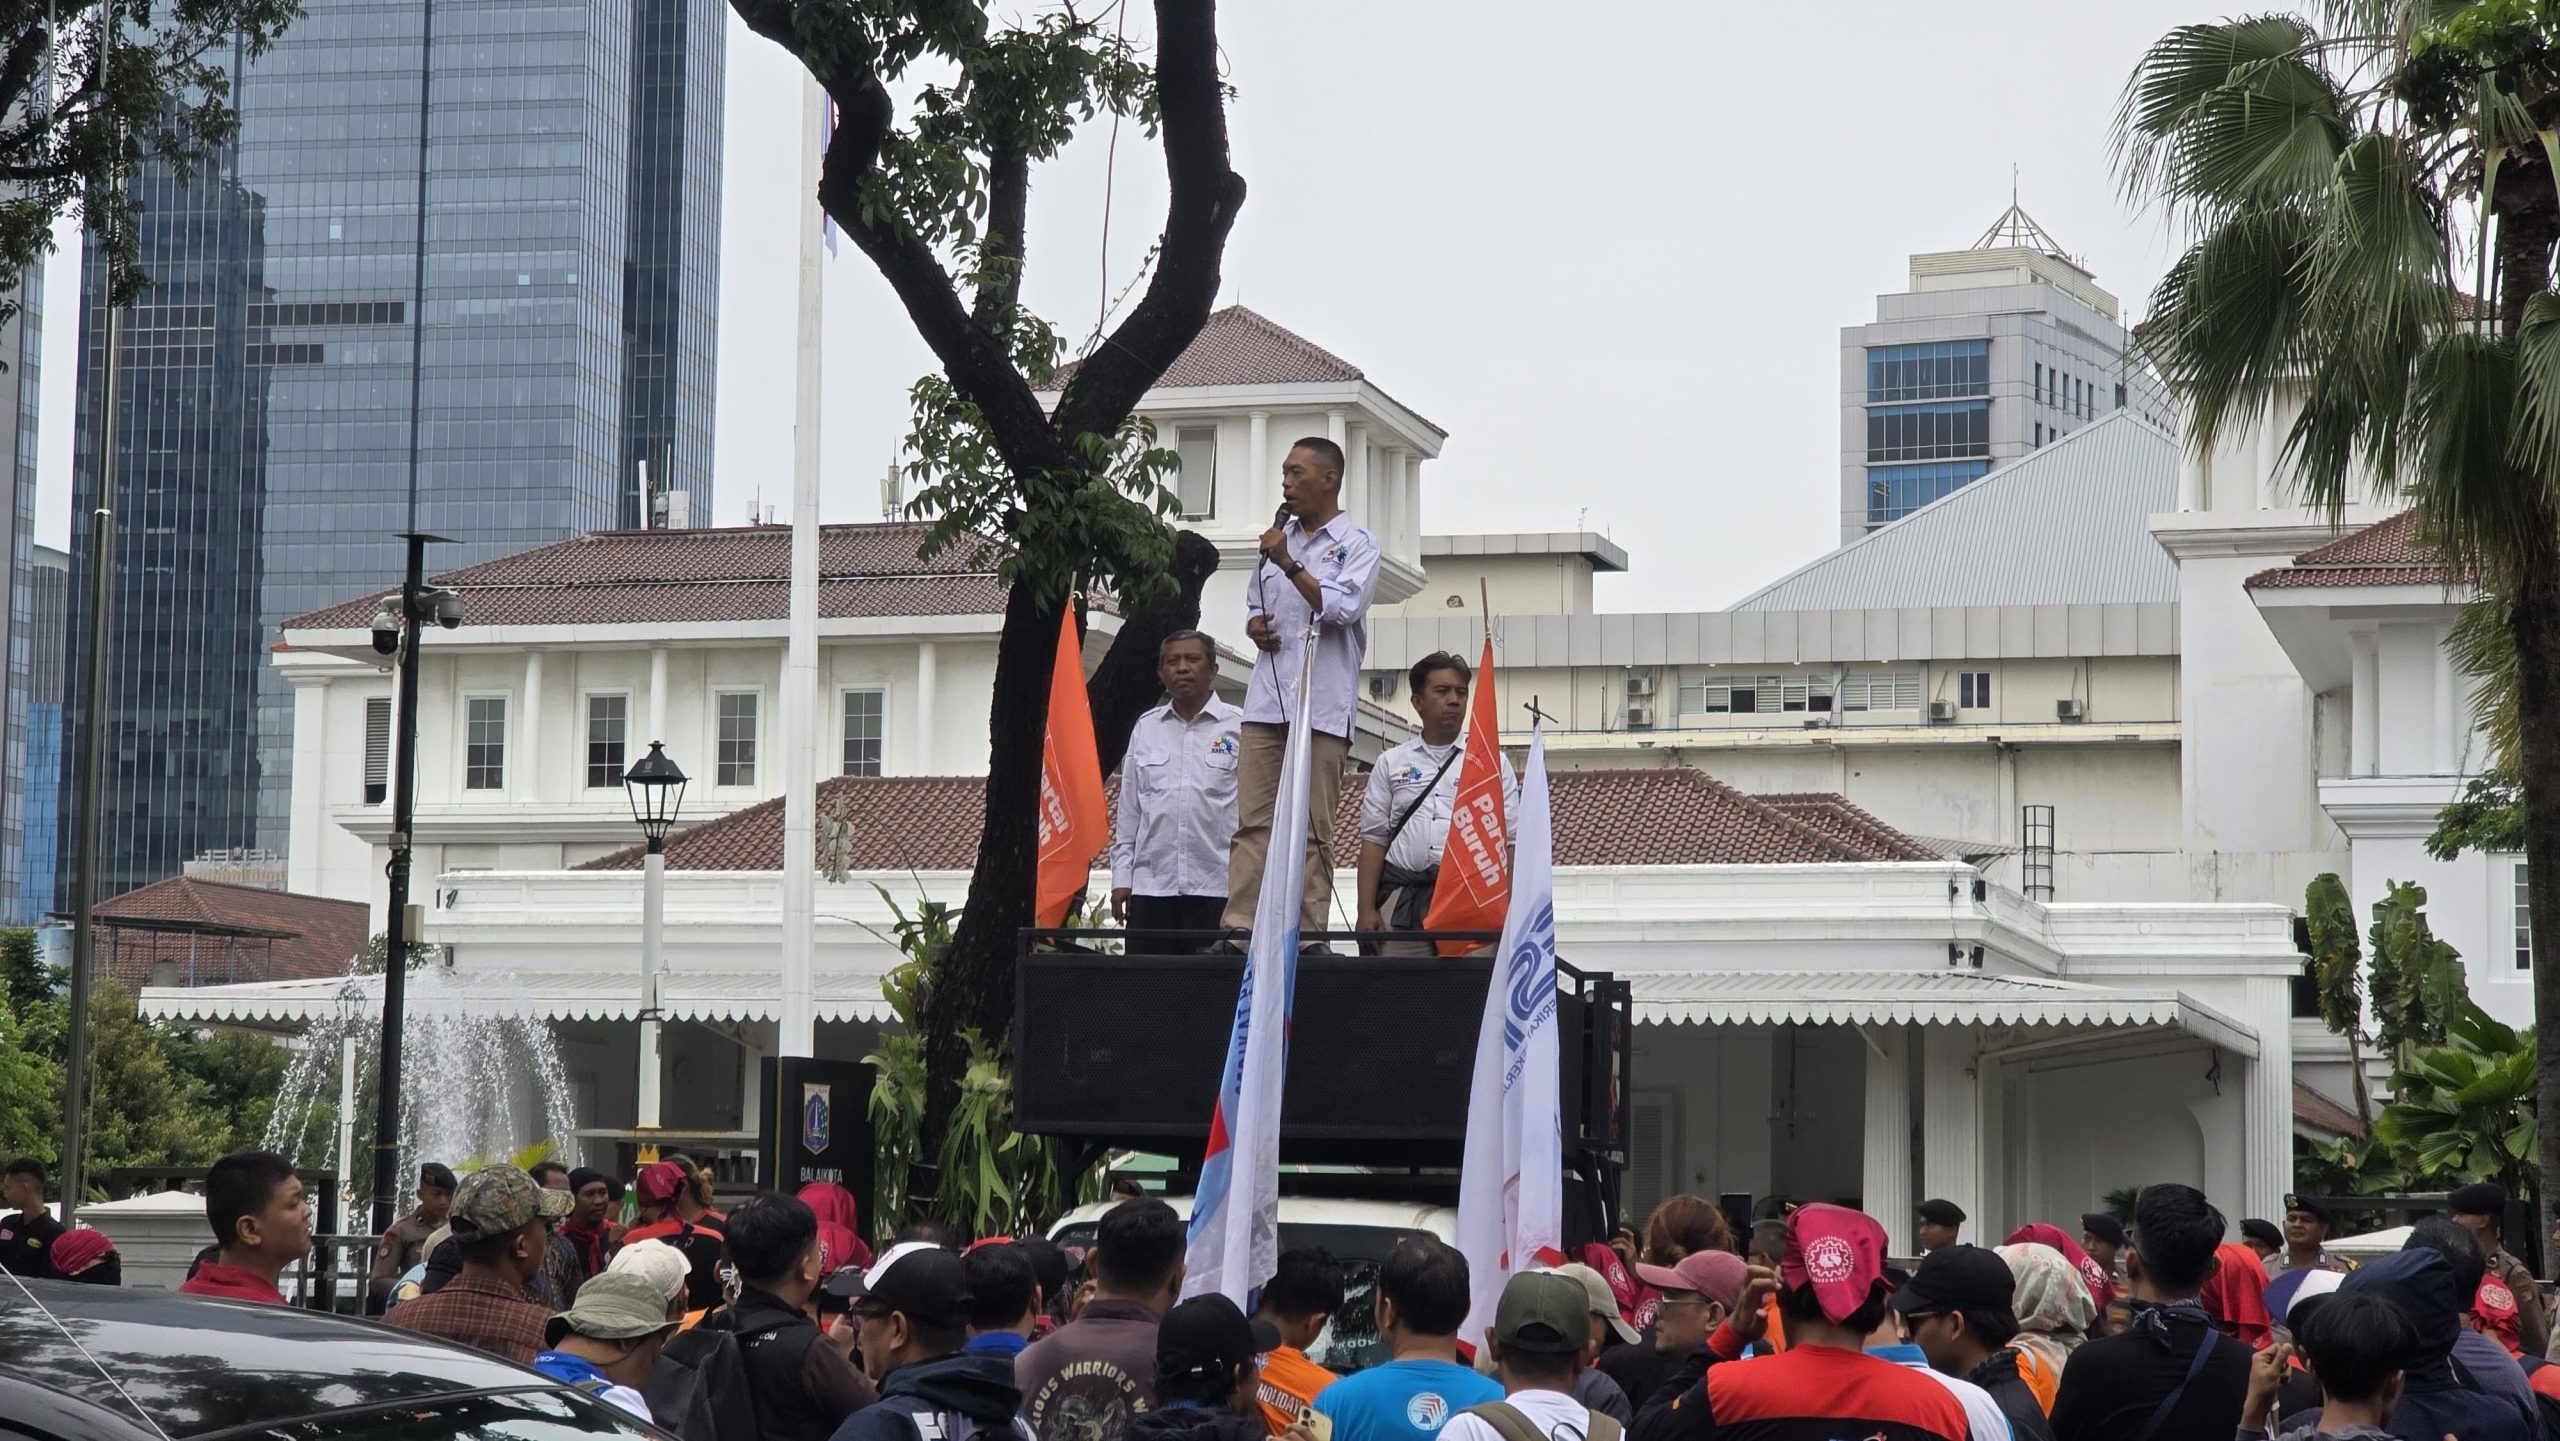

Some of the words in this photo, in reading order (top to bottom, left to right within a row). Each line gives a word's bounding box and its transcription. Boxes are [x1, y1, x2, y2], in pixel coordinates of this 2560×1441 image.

[1453, 805, 1500, 887] Buruh
[800, 1167, 843, 1183] BALAIKOTA
[1060, 1361, 1136, 1393] WARRIORS
[1132, 1397, 1149, 1414] W
